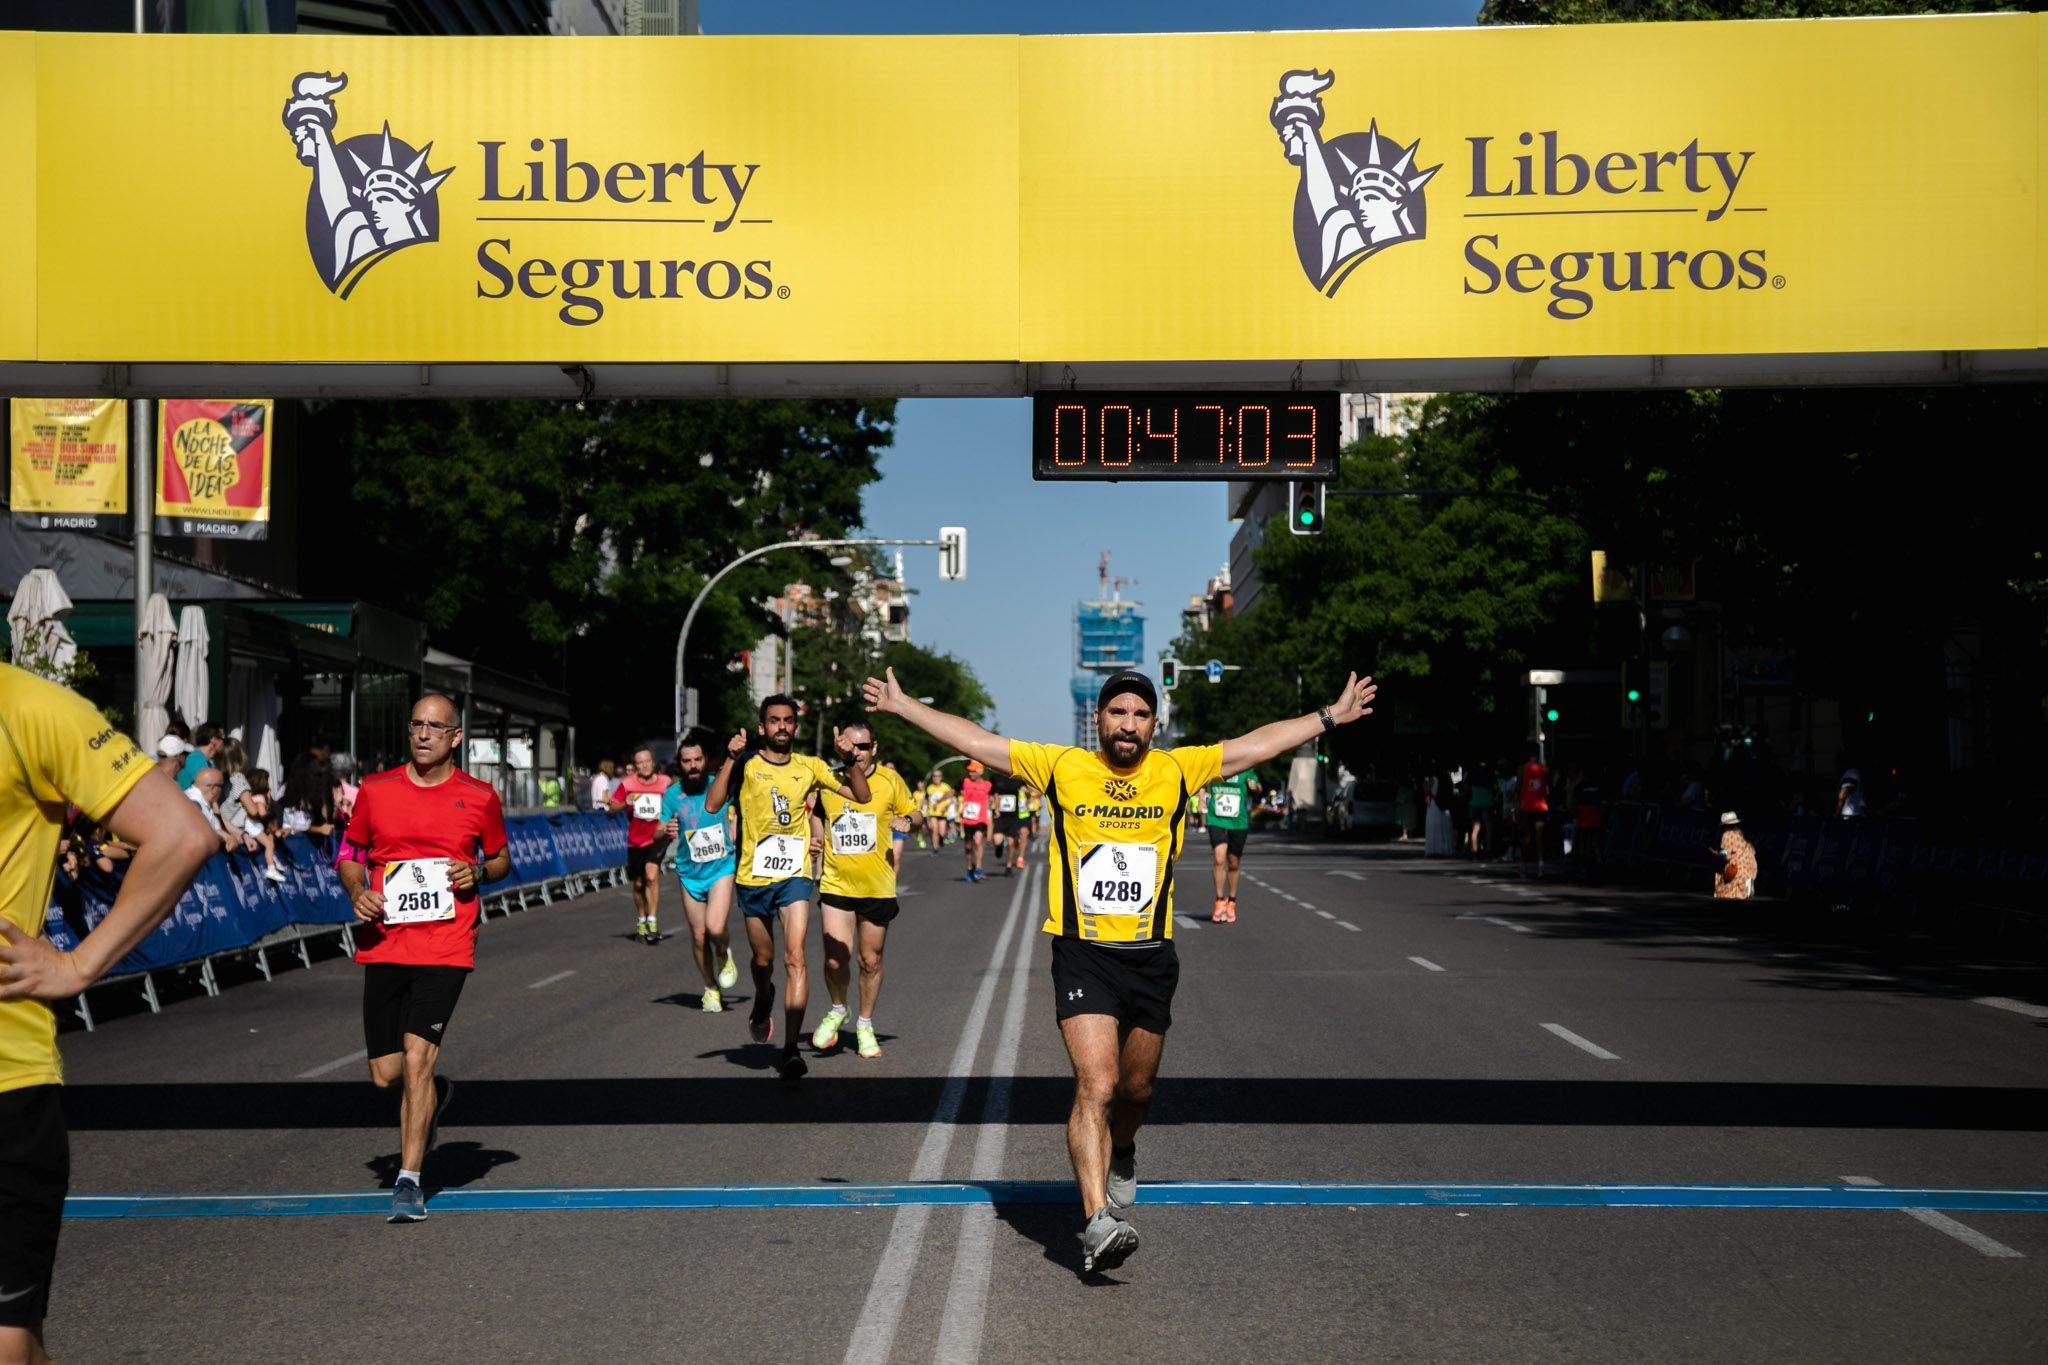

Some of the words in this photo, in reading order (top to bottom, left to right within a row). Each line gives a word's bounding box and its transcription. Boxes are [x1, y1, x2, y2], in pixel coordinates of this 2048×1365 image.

[477, 138, 760, 233] Liberty
[1464, 130, 1756, 221] Liberty
[193, 421, 210, 435] LA
[1055, 404, 1316, 467] 00:47:03
[176, 427, 229, 455] NOCHE
[185, 454, 200, 469] DE
[204, 454, 236, 474] LAS
[188, 471, 236, 499] IDEAS
[53, 518, 98, 529] MADRID
[196, 522, 240, 535] MADRID
[780, 814, 790, 823] 13
[1099, 821, 1141, 830] SPORTS
[840, 834, 868, 847] 1398
[398, 890, 439, 912] 2581
[1092, 880, 1142, 902] 4289
